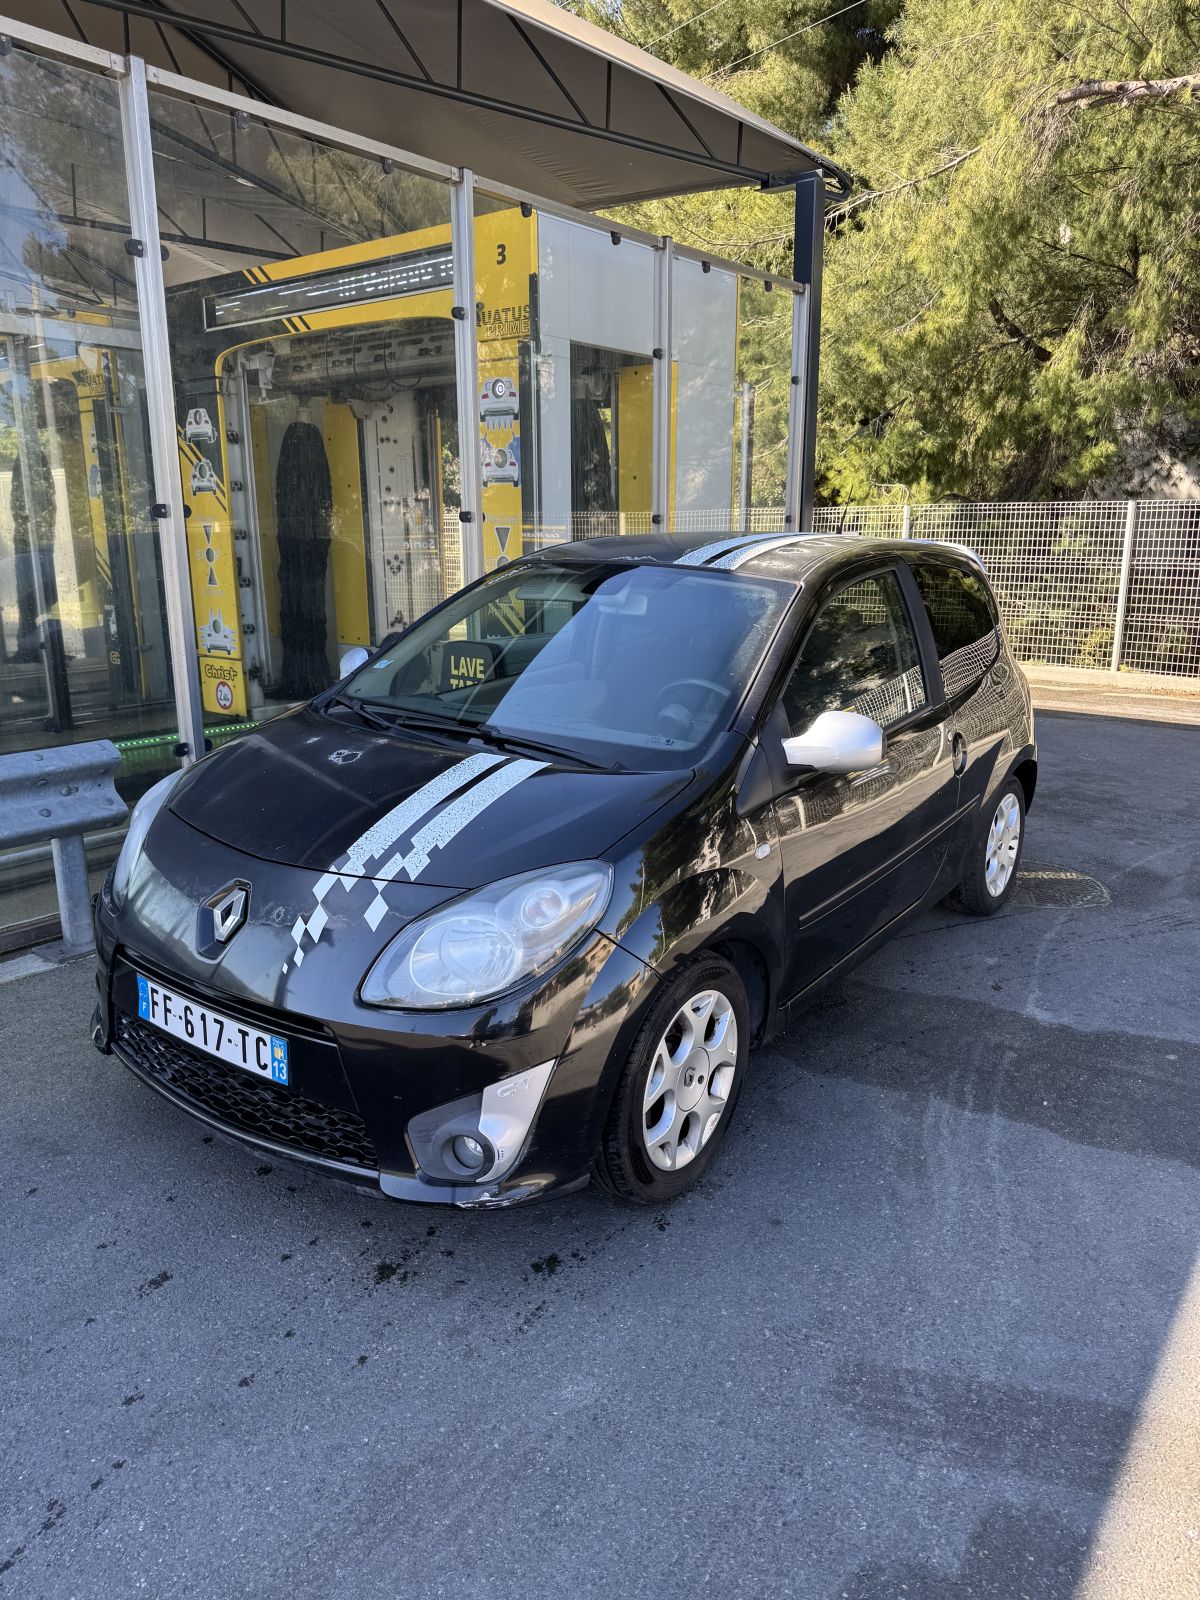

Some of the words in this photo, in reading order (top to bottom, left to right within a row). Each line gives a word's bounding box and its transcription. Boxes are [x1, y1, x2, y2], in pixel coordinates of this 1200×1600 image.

[496, 243, 507, 265] 3
[487, 318, 531, 338] PRIME
[205, 664, 237, 681] Christ
[450, 655, 485, 679] LAVE
[142, 1001, 147, 1011] F
[150, 986, 268, 1070] FF-617-TC
[273, 1061, 287, 1080] 13
